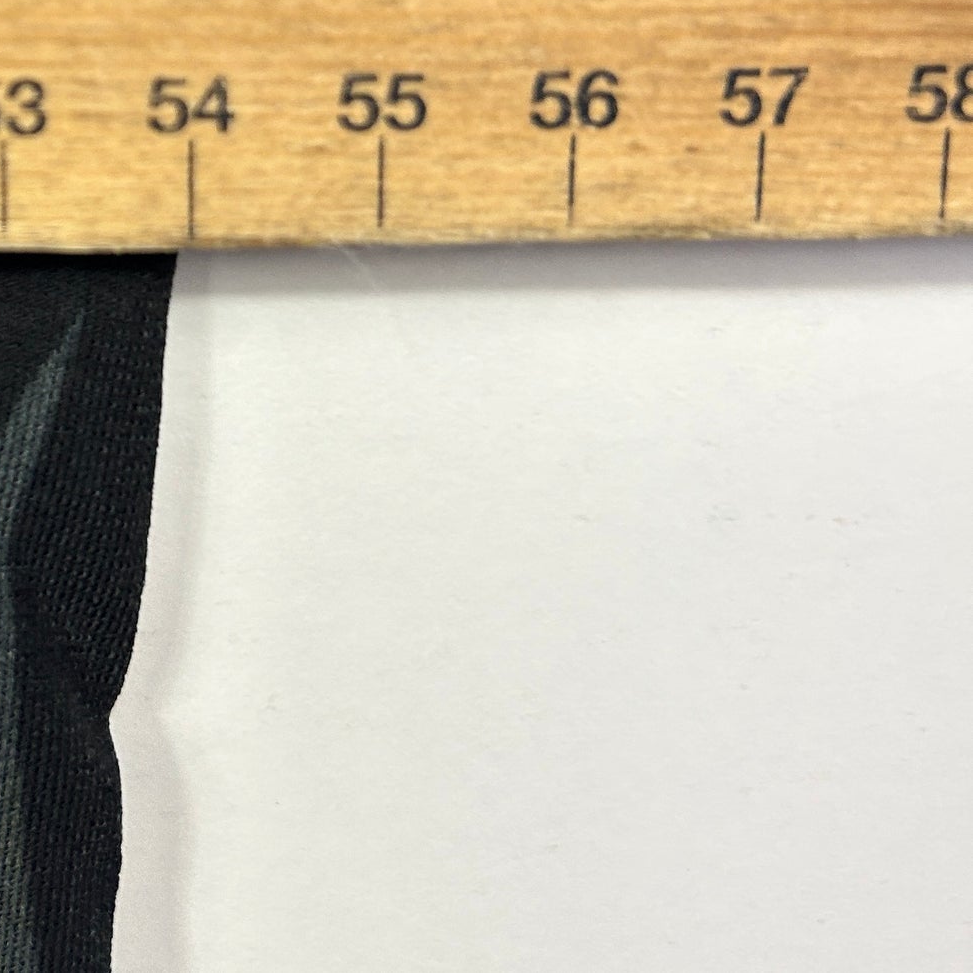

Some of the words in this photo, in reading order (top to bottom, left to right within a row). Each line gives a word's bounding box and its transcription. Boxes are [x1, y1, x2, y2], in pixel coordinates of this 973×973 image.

[146, 75, 235, 135] 54
[337, 72, 428, 133] 55
[528, 69, 620, 129] 56
[718, 66, 810, 127] 57
